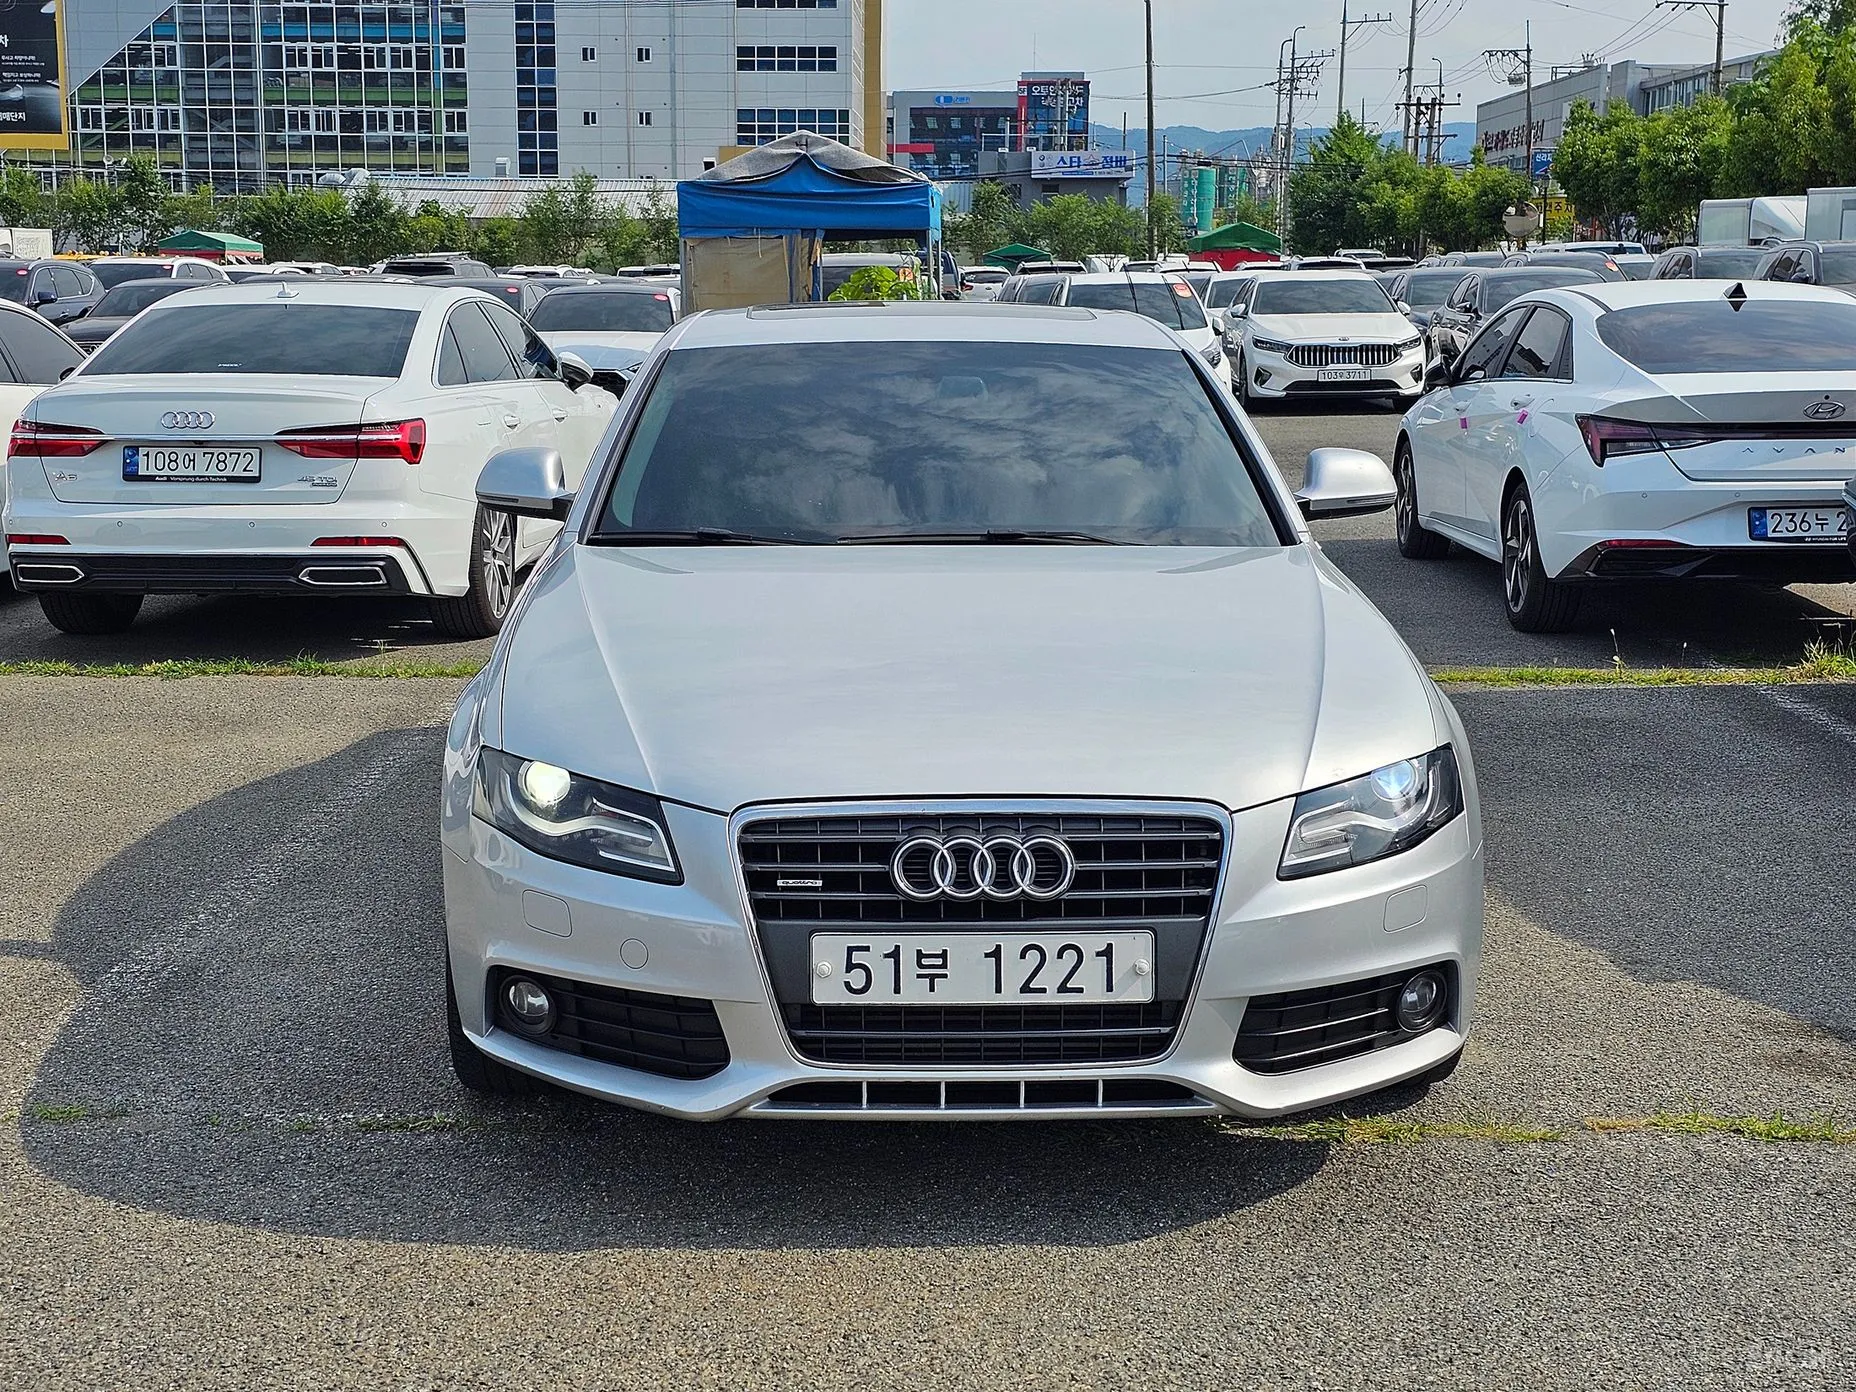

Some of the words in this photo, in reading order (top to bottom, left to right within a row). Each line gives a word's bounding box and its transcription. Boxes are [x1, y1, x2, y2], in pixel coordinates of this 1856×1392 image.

[1057, 156, 1082, 168] 스타
[1346, 371, 1367, 380] 3711
[142, 451, 196, 472] 108어
[202, 451, 254, 473] 7872
[1770, 512, 1829, 534] 236누
[843, 943, 949, 995] 51부
[983, 942, 1115, 994] 1221
